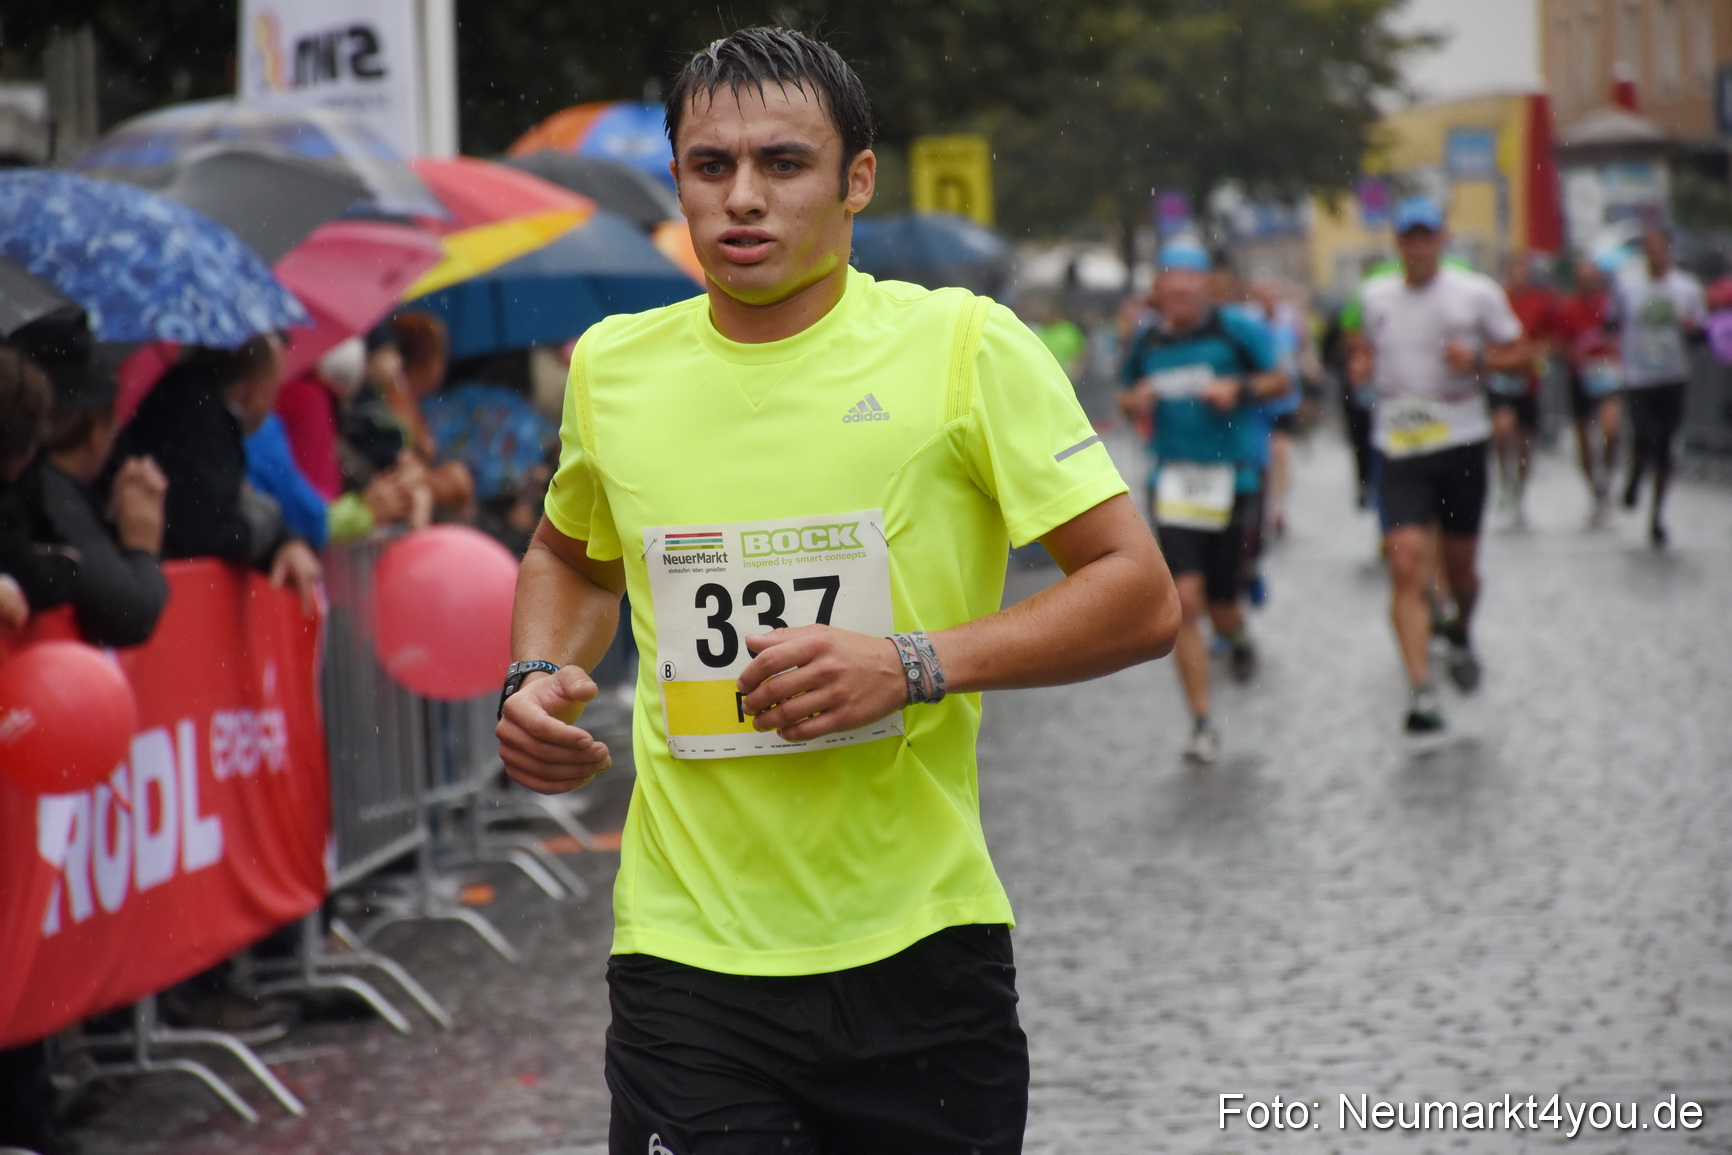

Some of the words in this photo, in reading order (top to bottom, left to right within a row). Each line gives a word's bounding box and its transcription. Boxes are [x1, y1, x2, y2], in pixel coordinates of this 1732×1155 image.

[842, 410, 891, 423] adidas
[741, 523, 863, 557] BOCK
[662, 551, 728, 565] NeuerMarkt
[743, 557, 780, 569] inspired
[782, 556, 793, 566] by
[795, 554, 823, 564] smart
[825, 550, 867, 561] concepts
[694, 575, 841, 668] 337
